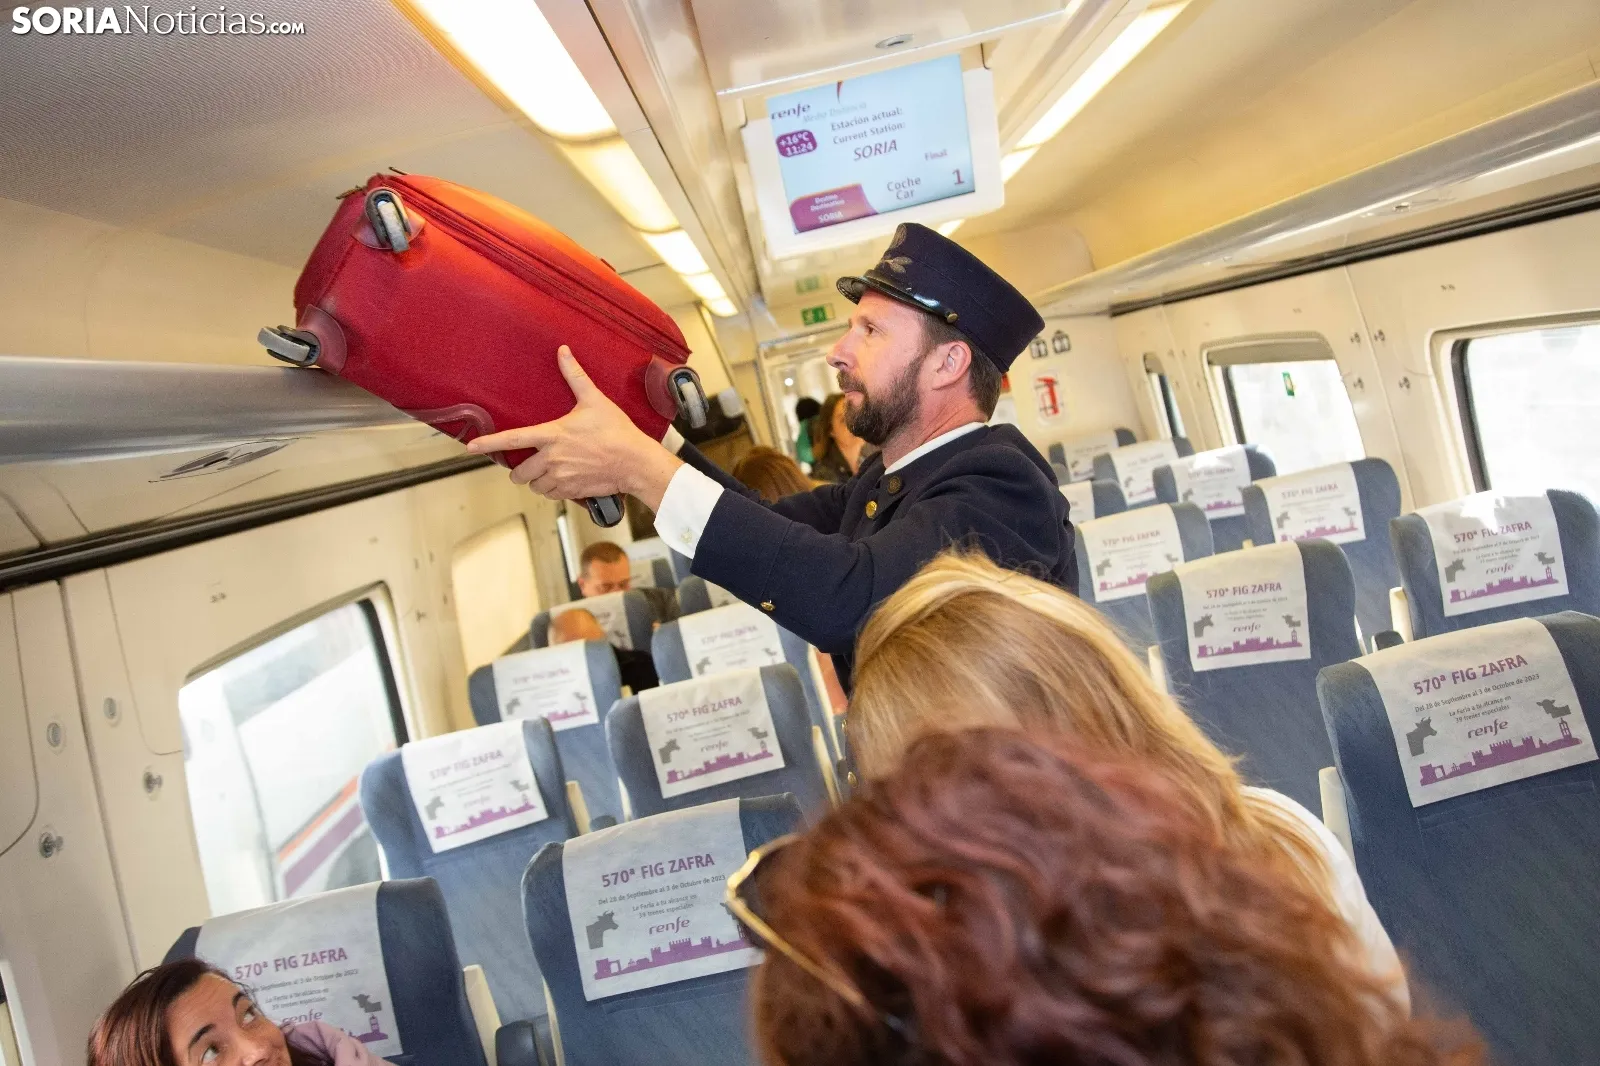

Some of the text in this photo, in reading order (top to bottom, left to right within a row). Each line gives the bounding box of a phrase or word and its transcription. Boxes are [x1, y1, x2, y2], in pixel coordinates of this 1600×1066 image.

[771, 103, 811, 120] renfe
[830, 114, 870, 131] Estación
[832, 130, 868, 145] Current
[853, 139, 898, 161] SORIA
[924, 149, 948, 161] Final
[886, 175, 922, 192] Coche
[952, 168, 965, 186] 1
[895, 189, 915, 201] Car
[1500, 521, 1532, 534] ZAFRA
[1232, 585, 1249, 596] FIG
[1251, 582, 1282, 594] ZAFRA
[1452, 667, 1477, 685] FIG
[1478, 654, 1528, 678] ZAFRA
[1441, 693, 1471, 705] Septiembre
[1492, 681, 1515, 691] Octubre
[1524, 674, 1540, 683] 2023
[692, 705, 710, 717] FIG
[711, 696, 743, 712] ZAFRA
[1467, 718, 1509, 739] renfe
[641, 862, 665, 880] FIG
[668, 853, 716, 874] ZAFRA
[711, 874, 726, 883] 2023
[648, 916, 690, 935] renfe
[274, 955, 298, 973] FIG
[302, 947, 348, 967] ZAFRA
